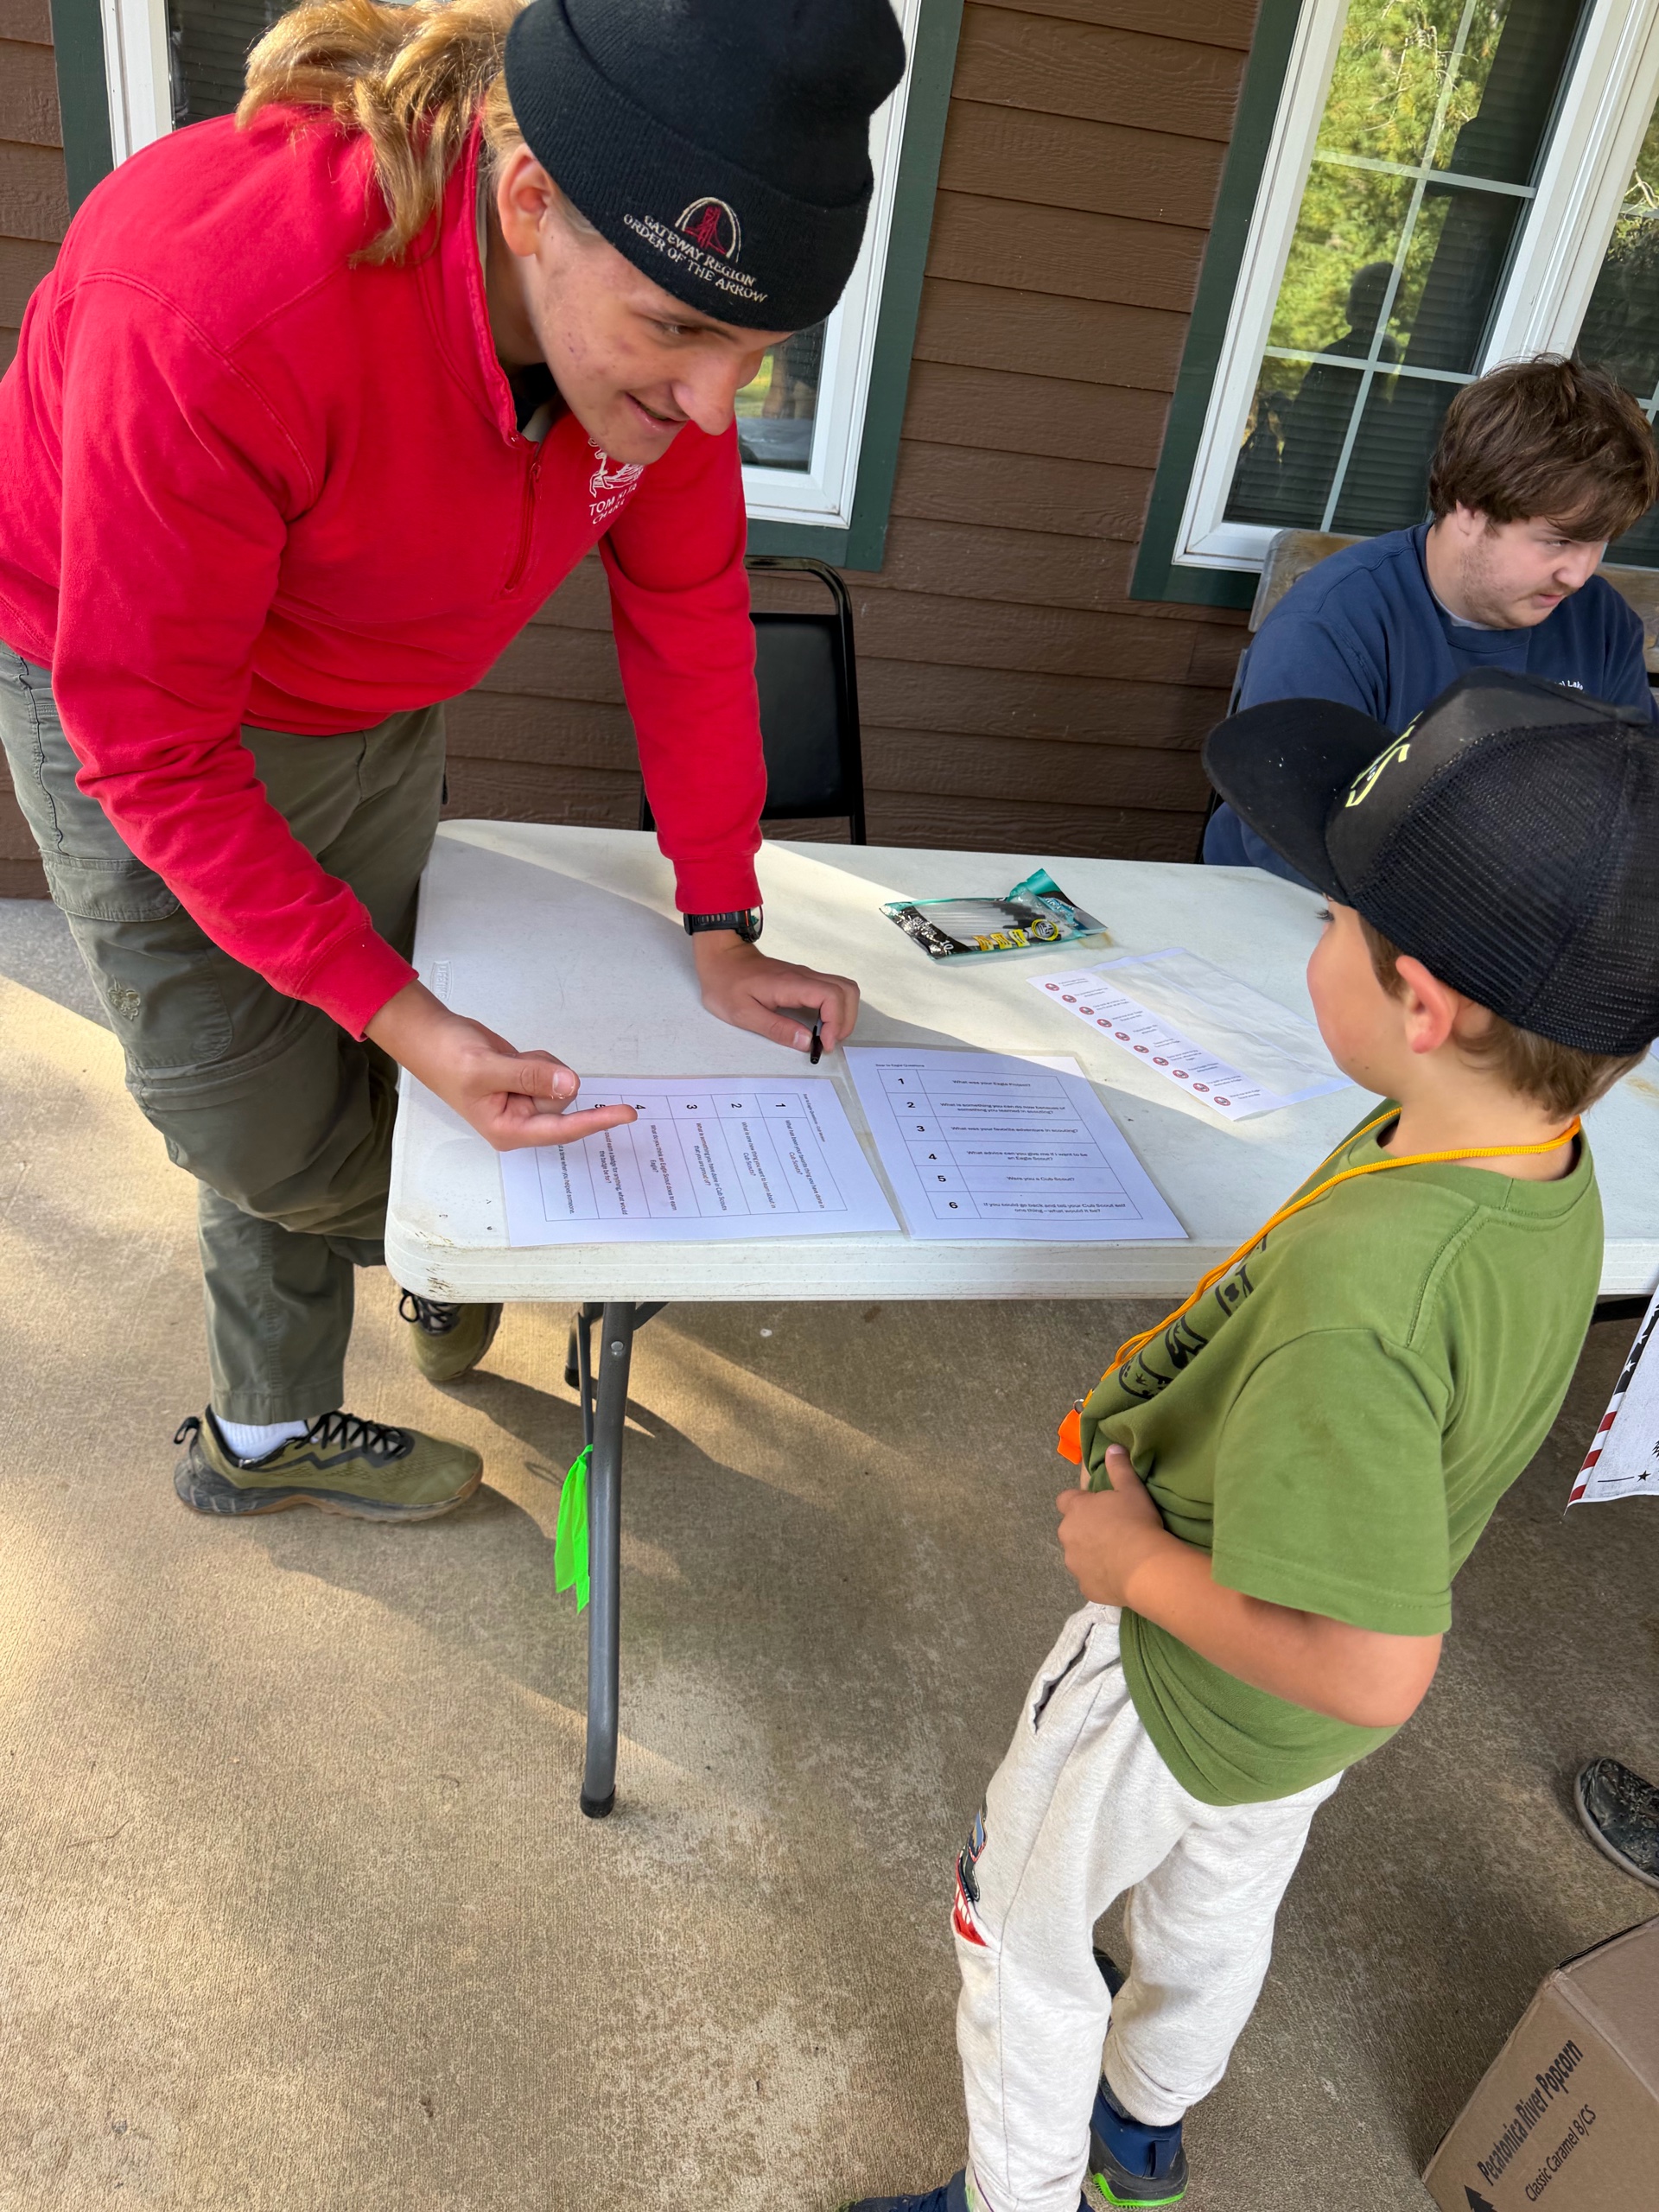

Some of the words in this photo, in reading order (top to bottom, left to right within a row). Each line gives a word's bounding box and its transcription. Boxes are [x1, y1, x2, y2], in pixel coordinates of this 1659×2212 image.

[623, 214, 665, 251] ORDER
[667, 247, 686, 263] OF
[687, 259, 715, 281] THE
[715, 278, 768, 302] ARROW
[645, 215, 704, 260] GATEWAY
[703, 255, 756, 287] REGION
[589, 496, 615, 516] TOM
[766, 1192, 775, 1204] about
[1477, 2119, 1529, 2186] Pecatonica
[1516, 2087, 1548, 2131] River
[1535, 2040, 1583, 2101] Popcorn
[1525, 2166, 1552, 2202] Classic
[1546, 2126, 1580, 2173] Caramel
[1573, 2104, 1596, 2136] 8/CS
